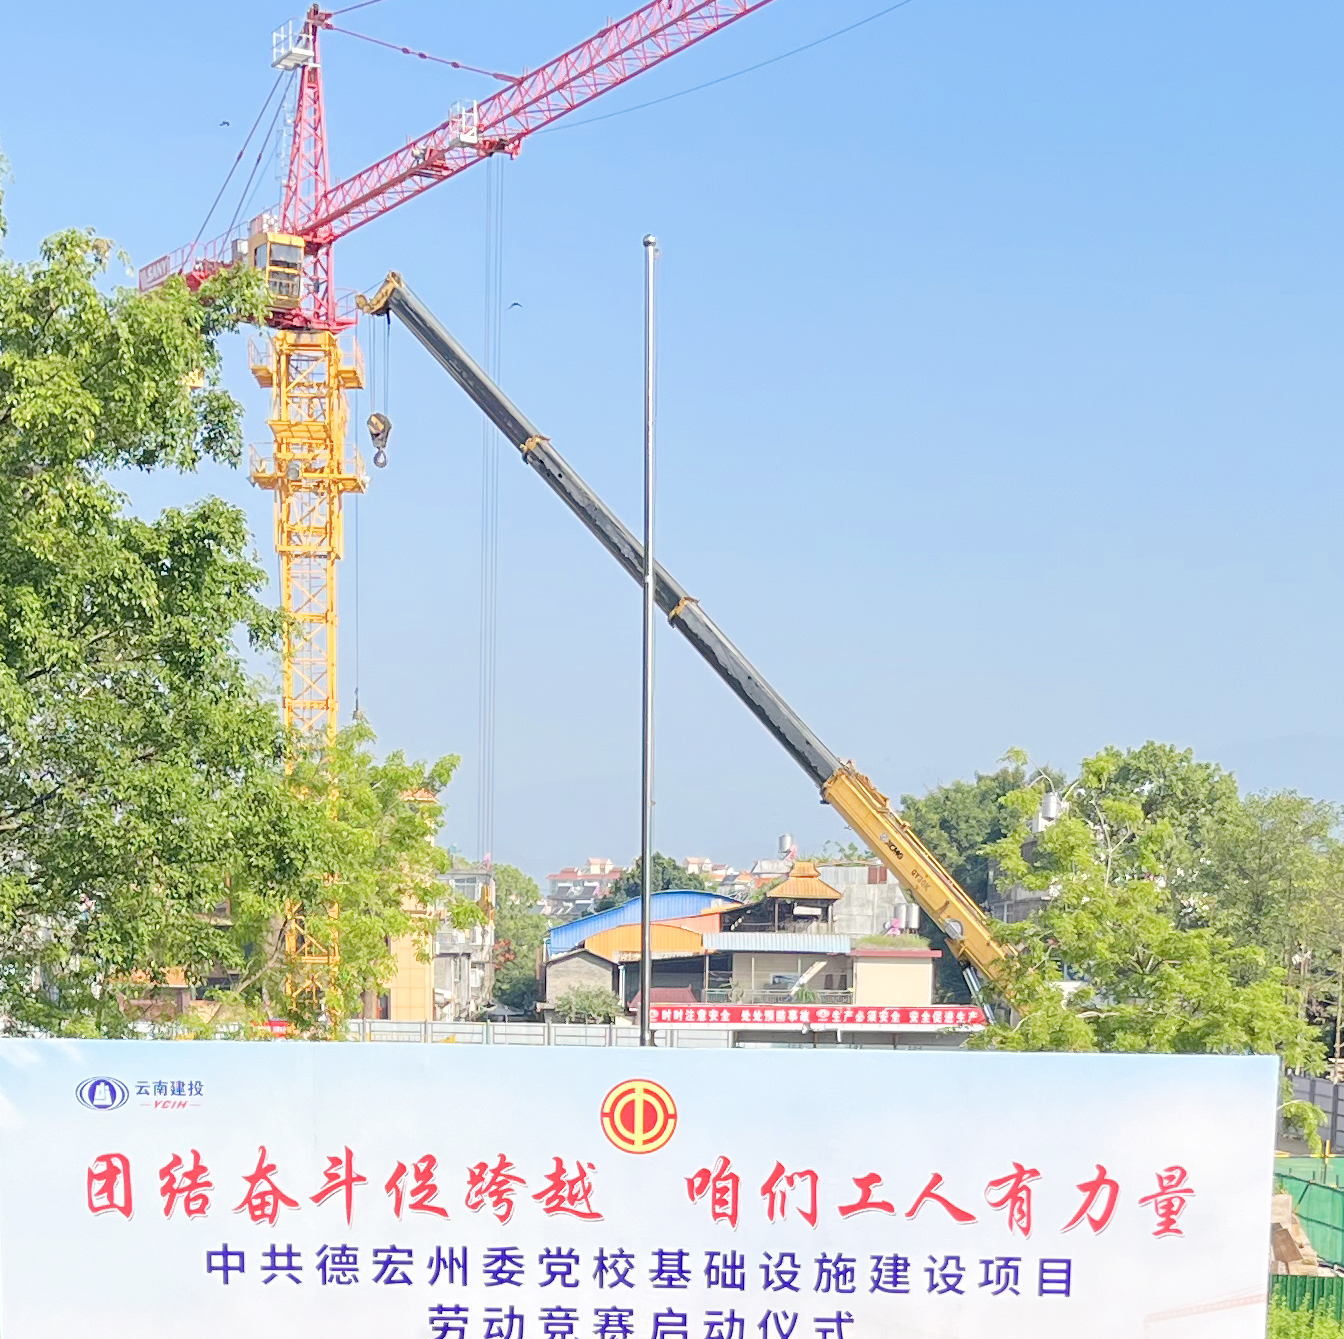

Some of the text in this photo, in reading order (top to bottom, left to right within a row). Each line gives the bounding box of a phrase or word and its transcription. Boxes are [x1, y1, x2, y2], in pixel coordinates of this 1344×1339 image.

[135, 1080, 204, 1097] 云南建投
[154, 1100, 188, 1110] YCIH
[86, 1146, 1196, 1240] 团结奋斗促跨越 咱们工人有力量
[205, 1243, 1074, 1298] 中共德宏州委党校基础设施建设项目
